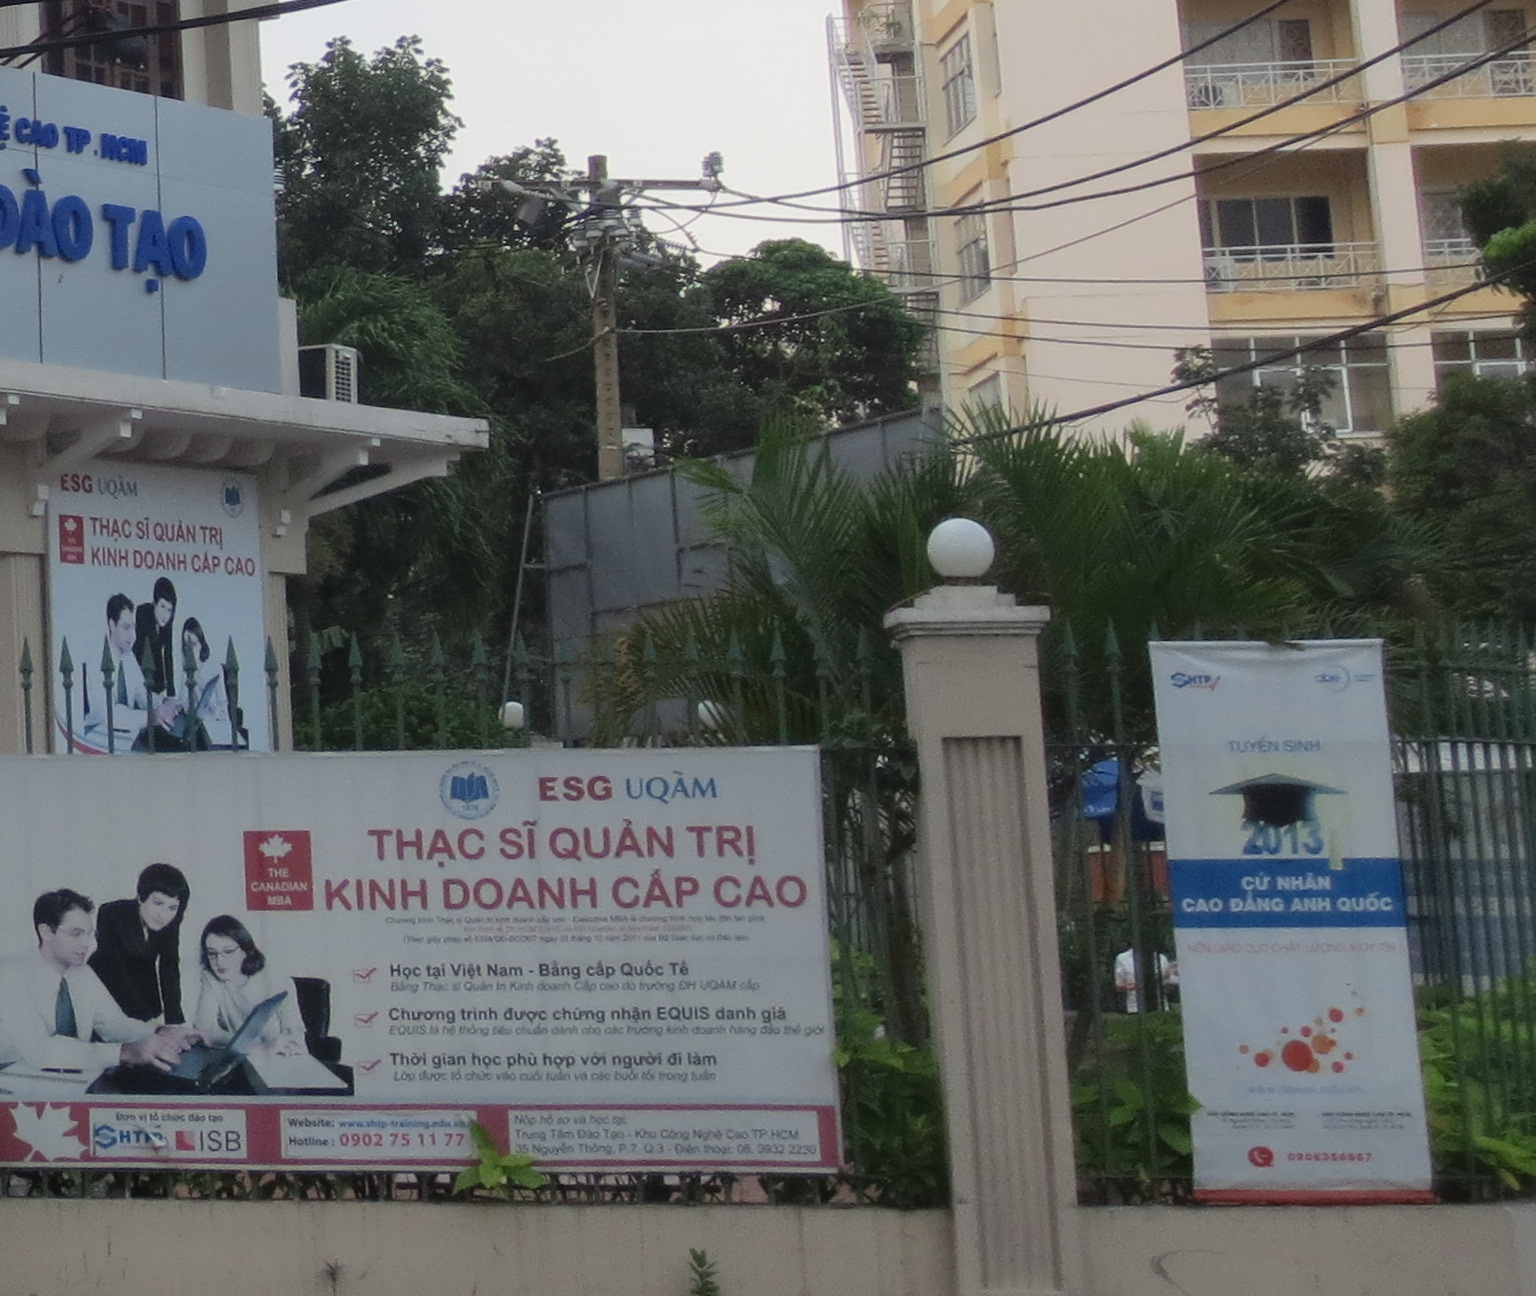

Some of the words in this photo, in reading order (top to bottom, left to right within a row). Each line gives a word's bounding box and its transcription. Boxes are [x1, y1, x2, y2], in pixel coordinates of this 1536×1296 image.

[15, 117, 59, 149] CAO
[103, 203, 207, 294] TẠO
[60, 474, 92, 493] ESG
[90, 517, 132, 542] THẠC
[136, 516, 149, 540] SĨ
[154, 520, 196, 543] QUẢN
[200, 526, 223, 549] TRỊ
[91, 548, 129, 567] KINH
[133, 550, 186, 571] DOANH
[224, 557, 256, 577] CAO
[1284, 740, 1321, 753] SINH
[538, 776, 613, 802] ESG
[625, 770, 718, 804] UQÀM
[367, 827, 486, 868] THẠC
[498, 820, 539, 860] SĨ
[548, 819, 674, 860] QUẢN
[686, 825, 756, 865] TRỊ
[268, 868, 289, 878] THE
[1278, 874, 1331, 891] NHÂN
[250, 882, 308, 892] CANADIAN
[324, 878, 429, 911] KINH
[442, 878, 598, 911] DOANH
[611, 868, 700, 910] CẤP
[713, 875, 808, 909] CAO
[267, 896, 292, 905] MBA
[1183, 898, 1223, 913] CAO
[1290, 898, 1331, 912] ANH
[1337, 892, 1392, 912] QUỐC
[390, 964, 421, 979] Học
[426, 964, 446, 979] tại
[451, 963, 482, 979] Việt
[487, 964, 523, 977] Nam
[539, 961, 581, 979] Bằng
[586, 961, 616, 979] cấp
[620, 961, 665, 977] Quốc
[389, 1007, 456, 1023] Chương
[504, 1007, 548, 1023] được
[552, 1007, 606, 1023] chứng
[611, 1007, 651, 1020] nhận
[657, 1007, 710, 1021] EQUIS
[390, 1053, 427, 1066] Thời
[431, 1054, 466, 1068] gian
[472, 1053, 501, 1067] học
[507, 1053, 537, 1068] phù
[543, 1054, 575, 1069] hợp
[612, 1053, 662, 1068] người
[667, 1053, 682, 1066] đi
[688, 1053, 717, 1066] làm
[200, 1130, 242, 1152] ISB
[339, 1133, 383, 1147] 0902
[389, 1133, 410, 1147] 75
[418, 1133, 436, 1147] 11
[444, 1133, 466, 1147] 77
